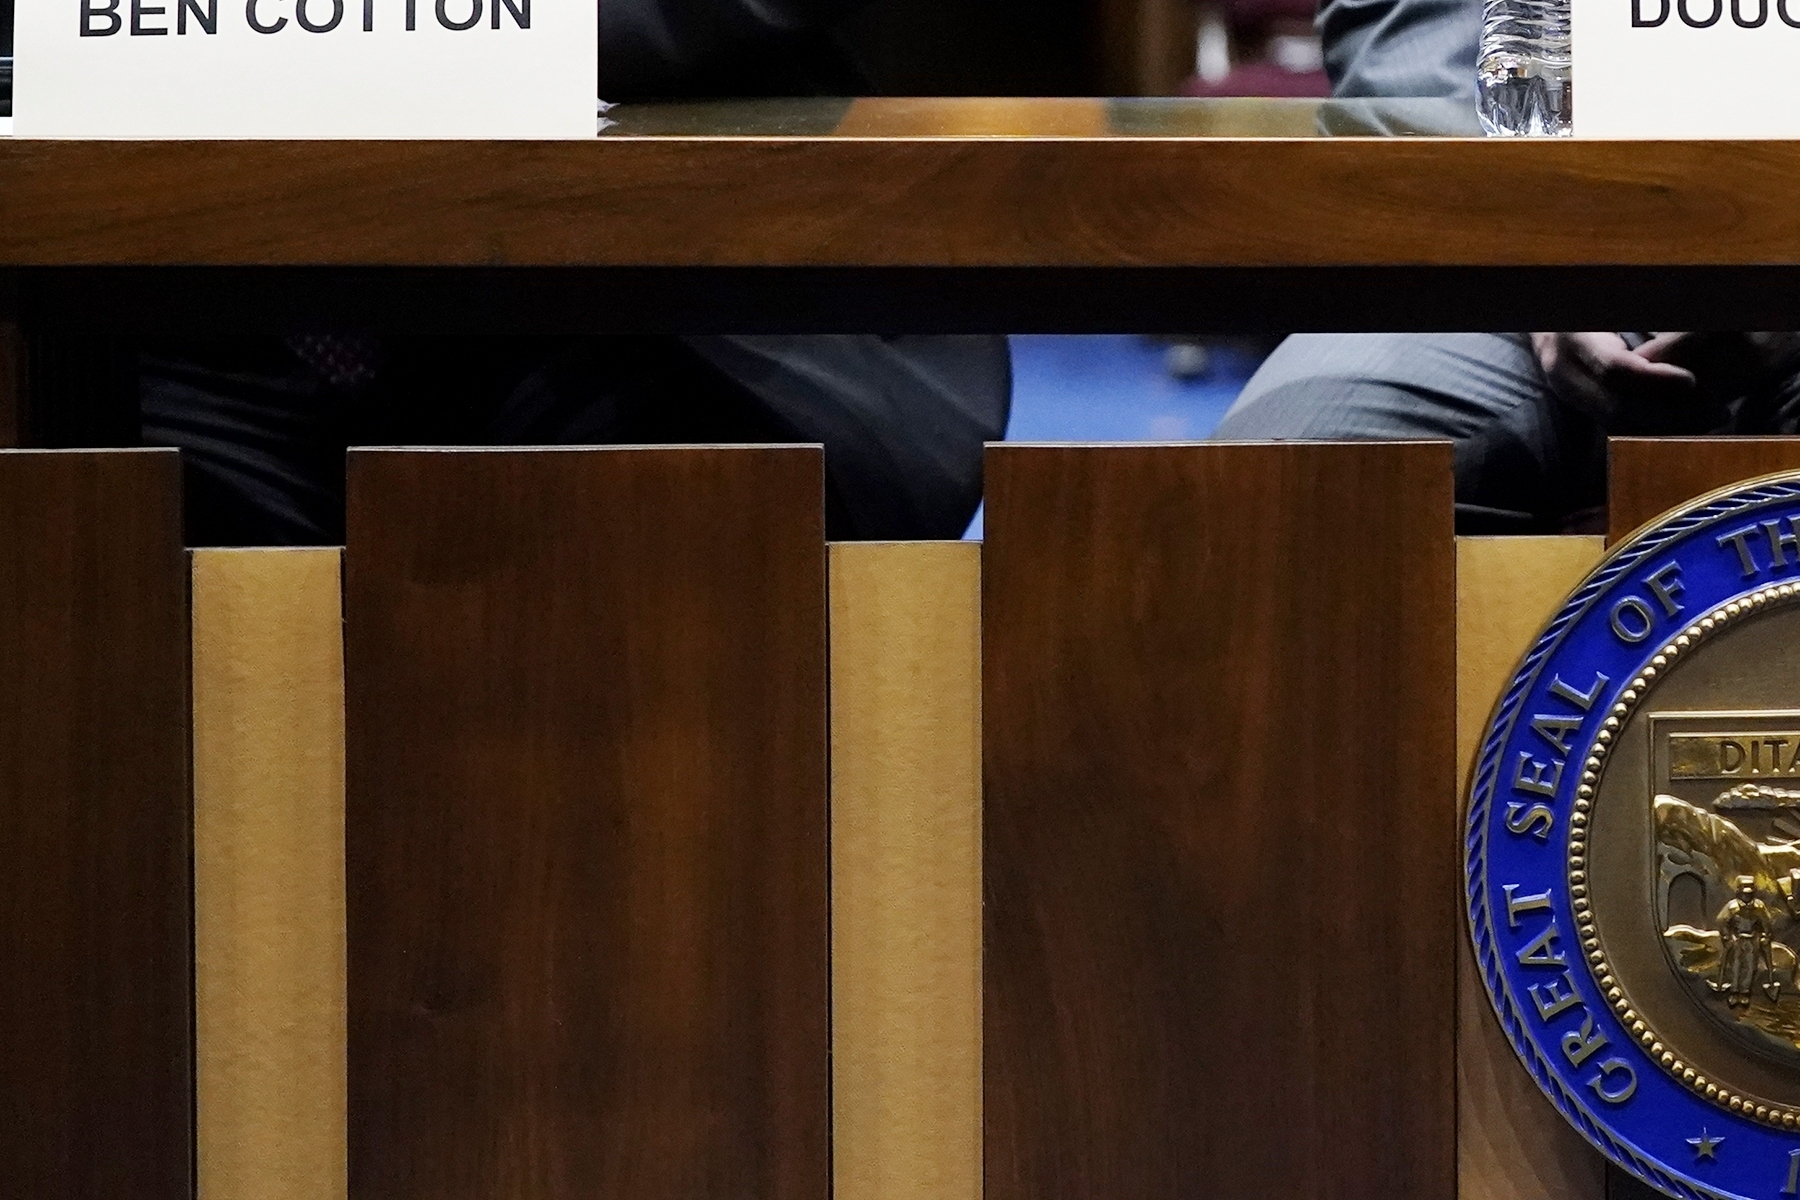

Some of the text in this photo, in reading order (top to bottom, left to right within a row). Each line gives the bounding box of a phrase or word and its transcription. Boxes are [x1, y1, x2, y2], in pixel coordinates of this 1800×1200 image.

[1611, 561, 1690, 645] OF
[1505, 671, 1611, 840] SEAL
[1503, 884, 1638, 1105] GREAT
